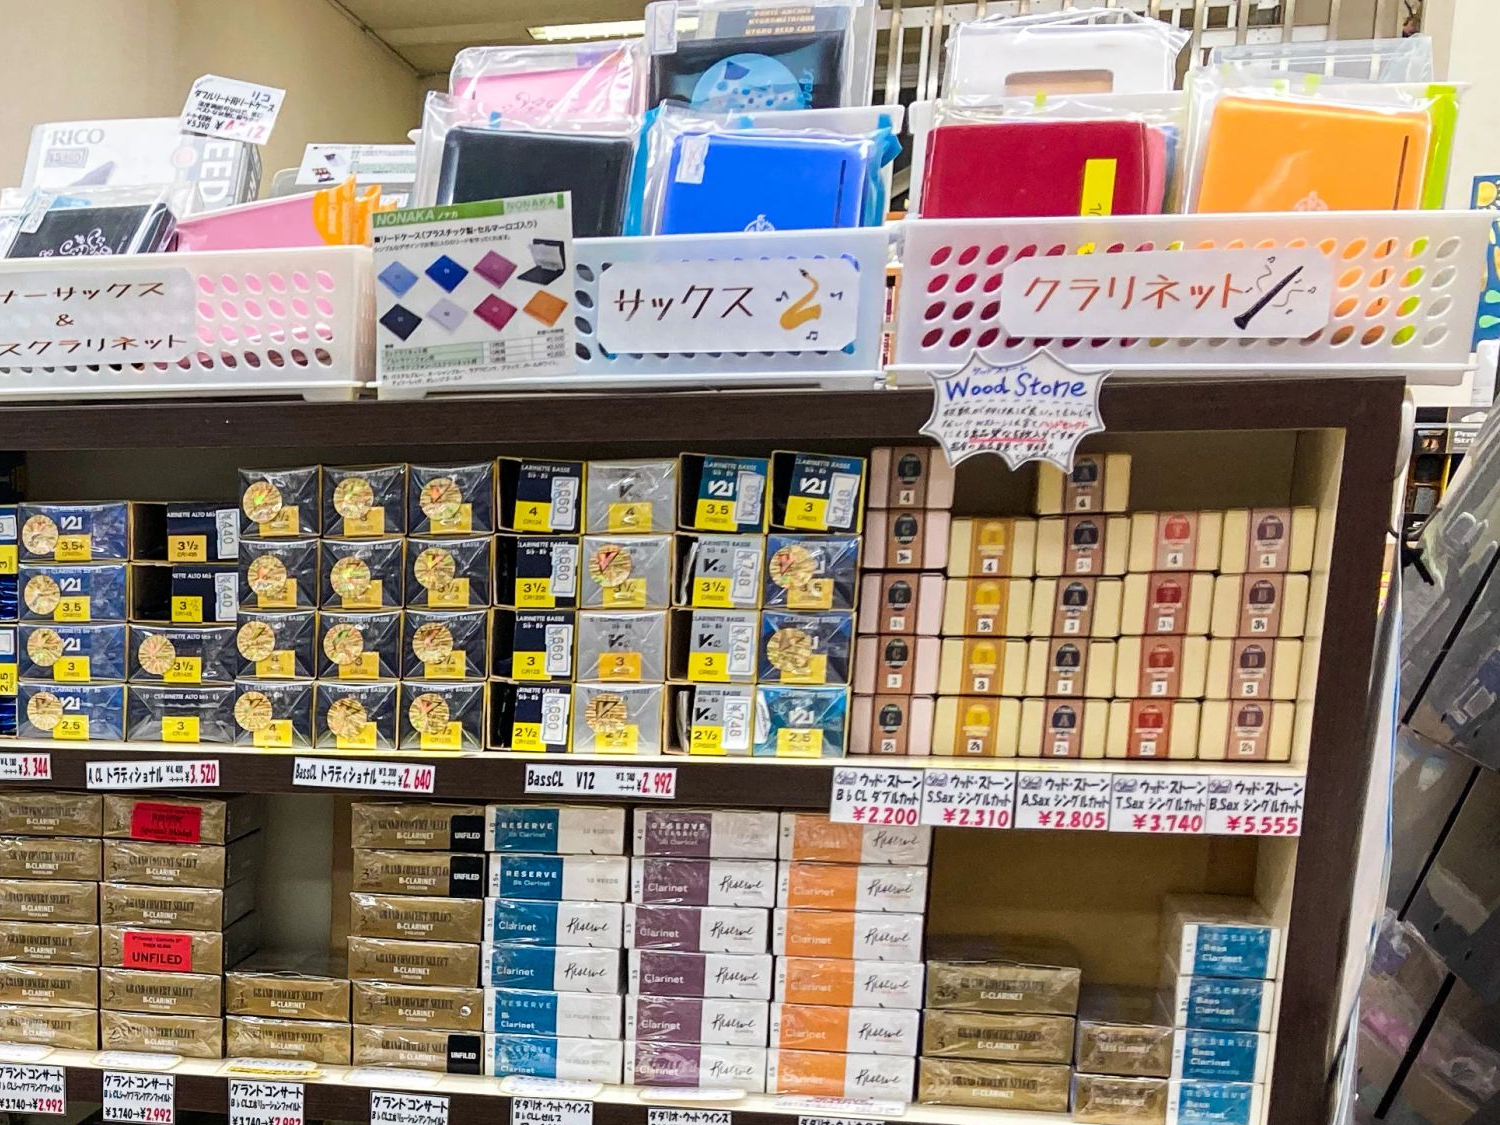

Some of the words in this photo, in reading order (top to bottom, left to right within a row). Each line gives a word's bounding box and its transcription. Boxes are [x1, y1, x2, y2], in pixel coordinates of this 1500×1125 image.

[52, 129, 105, 146] RICO
[376, 211, 434, 225] NONAKA
[1024, 273, 1246, 313] クラリネット
[614, 285, 755, 322] サックス
[56, 313, 73, 326] &
[945, 377, 1010, 401] Wood
[1015, 373, 1087, 397] Stone
[61, 516, 82, 530] V21
[528, 770, 565, 788] BassCL
[576, 771, 595, 789] V12
[501, 821, 554, 832] RESERVE
[455, 832, 480, 840] UNFILED
[648, 883, 688, 894] Clarinet
[498, 922, 537, 932] Clarinet
[792, 935, 832, 945] Clarinet
[132, 953, 183, 966] UNFILED
